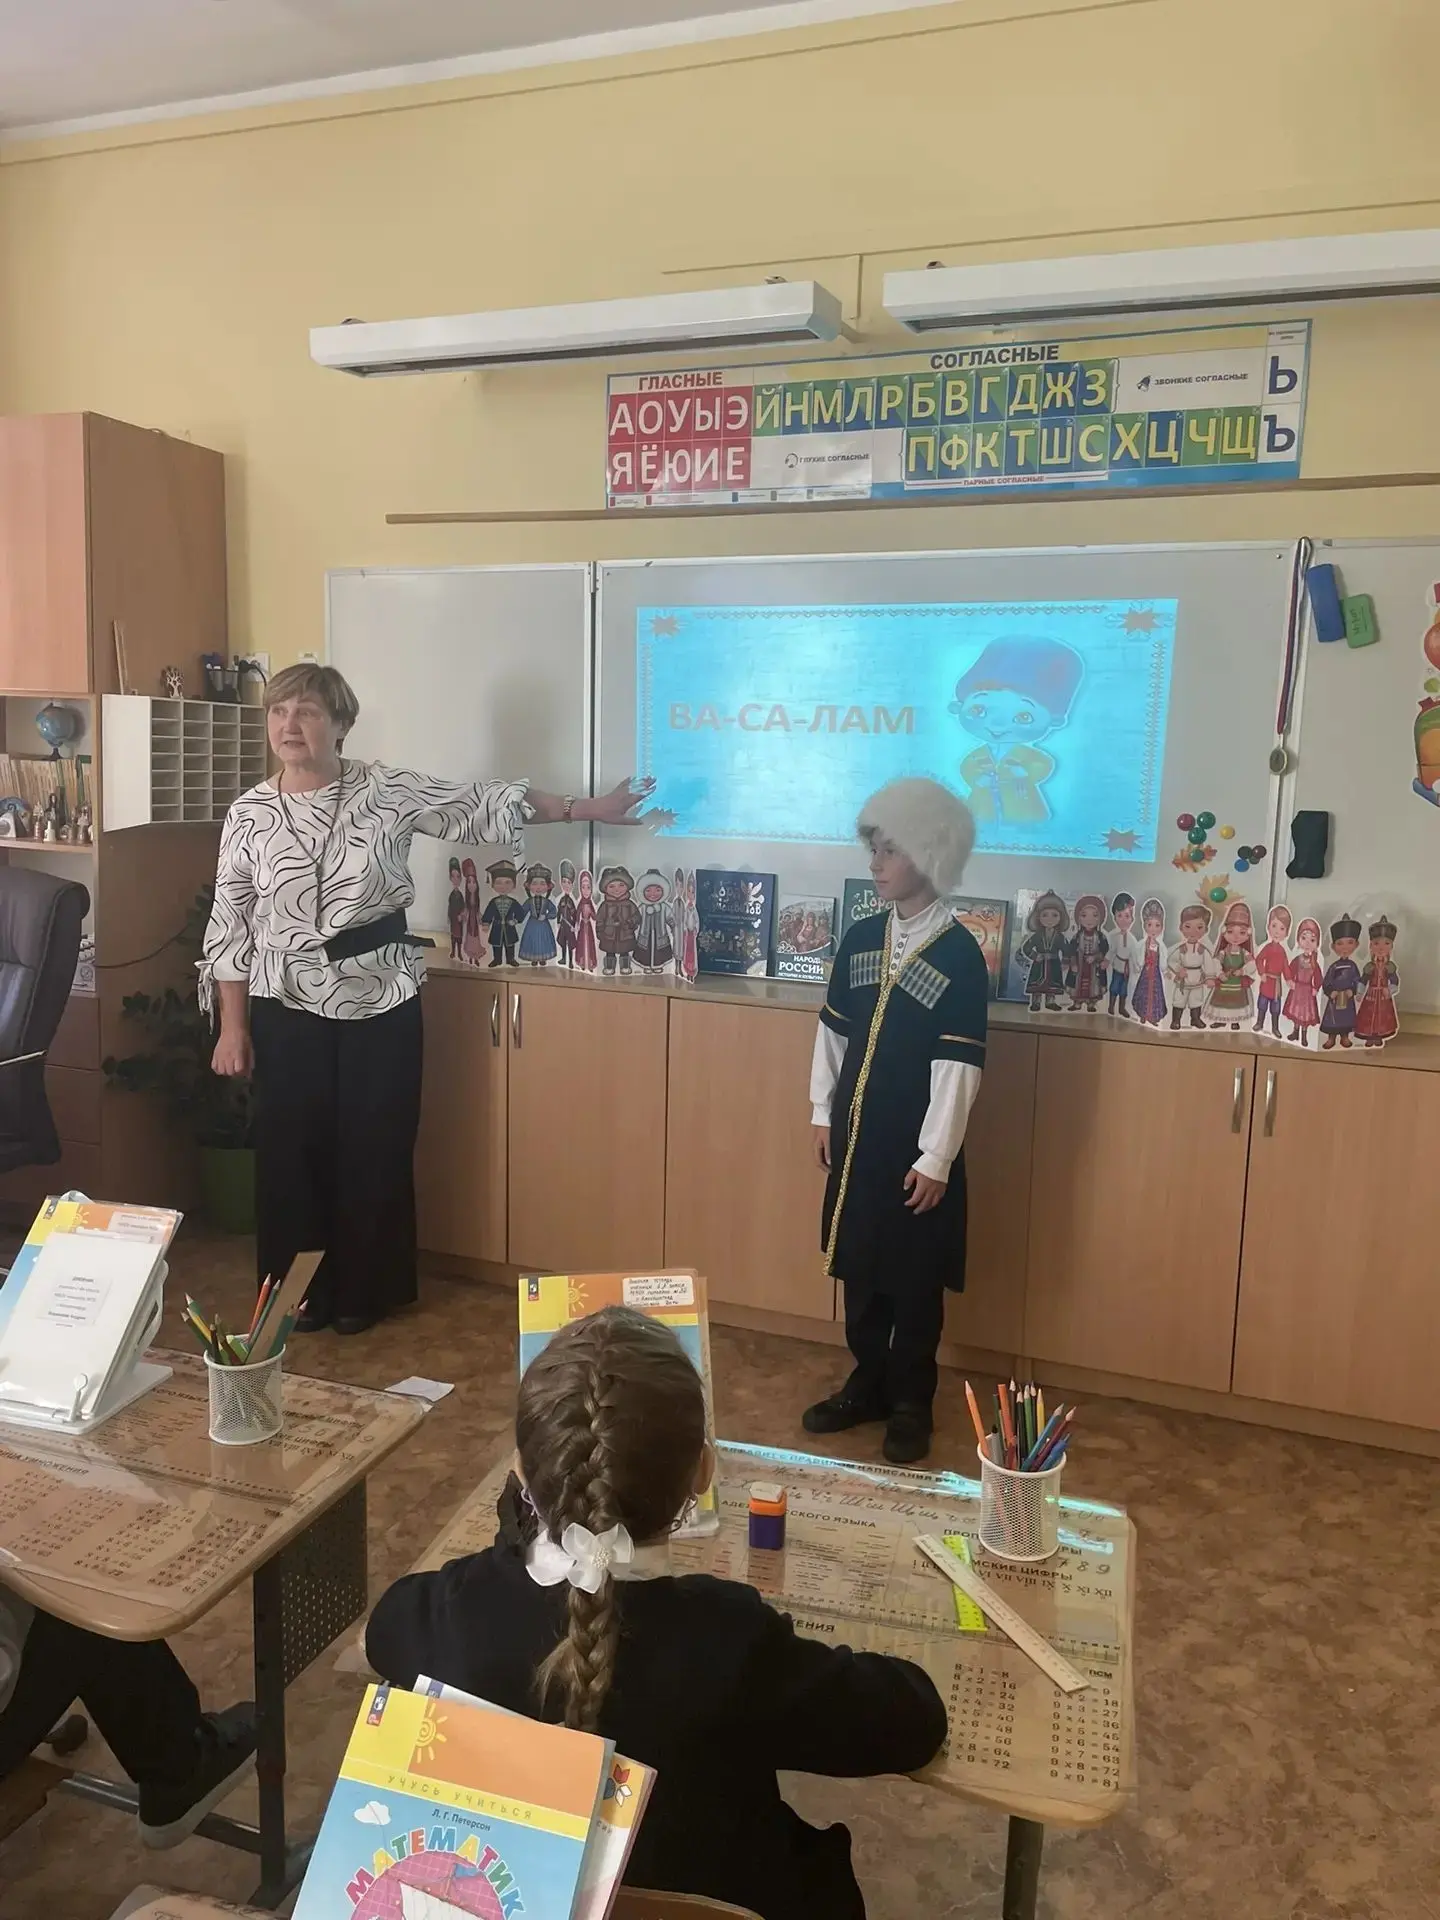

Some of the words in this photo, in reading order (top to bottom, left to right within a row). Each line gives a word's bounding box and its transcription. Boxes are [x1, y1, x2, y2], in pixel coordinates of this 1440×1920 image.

[930, 345, 1059, 370] СОГЛАСНЫЕ
[1154, 376, 1193, 385] ЗВОНКИЕ
[1195, 373, 1249, 383] СОГЛАСНЫЕ
[1268, 355, 1298, 395] Ь
[639, 371, 722, 391] ГЛАСНЫЕ
[1263, 414, 1296, 453] Ъ
[827, 453, 870, 462] СОГЛАСНЫЕ
[997, 476, 1045, 484] СОГЛАСНЫЕ
[668, 702, 915, 734] ВА-СА-ЛАМ
[779, 961, 824, 974] РОССИИ
[858, 1465, 933, 1482] НАПИСАНИЯ
[833, 1517, 877, 1529] ЯЗЫКА
[972, 1559, 1017, 1573] МСКИЕ
[1020, 1567, 1073, 1581] ЦИФРЫ
[1001, 1681, 1016, 1690] 16
[1000, 1692, 1015, 1700] 24
[998, 1703, 1015, 1711] 32
[1103, 1699, 1118, 1707] 18
[997, 1714, 1014, 1722] 40
[1103, 1709, 1118, 1718] 27
[996, 1725, 1012, 1733] 48
[1103, 1721, 1119, 1729] 36
[995, 1736, 1012, 1745] 56
[1103, 1732, 1119, 1741] 45
[1103, 1743, 1119, 1752] 54
[994, 1748, 1010, 1757] 64
[1103, 1755, 1120, 1764] 63
[993, 1760, 1010, 1769] 72
[1103, 1766, 1119, 1776] 72
[1103, 1779, 1119, 1791] 81
[388, 1775, 441, 1796] УЧУСЬ
[454, 1792, 532, 1820] УЧИТЬСЯ
[431, 1808, 441, 1819] Л.
[443, 1811, 450, 1822] Г.
[451, 1813, 491, 1832] Петерсон
[345, 1825, 527, 1920] МАТЕМАТИК
